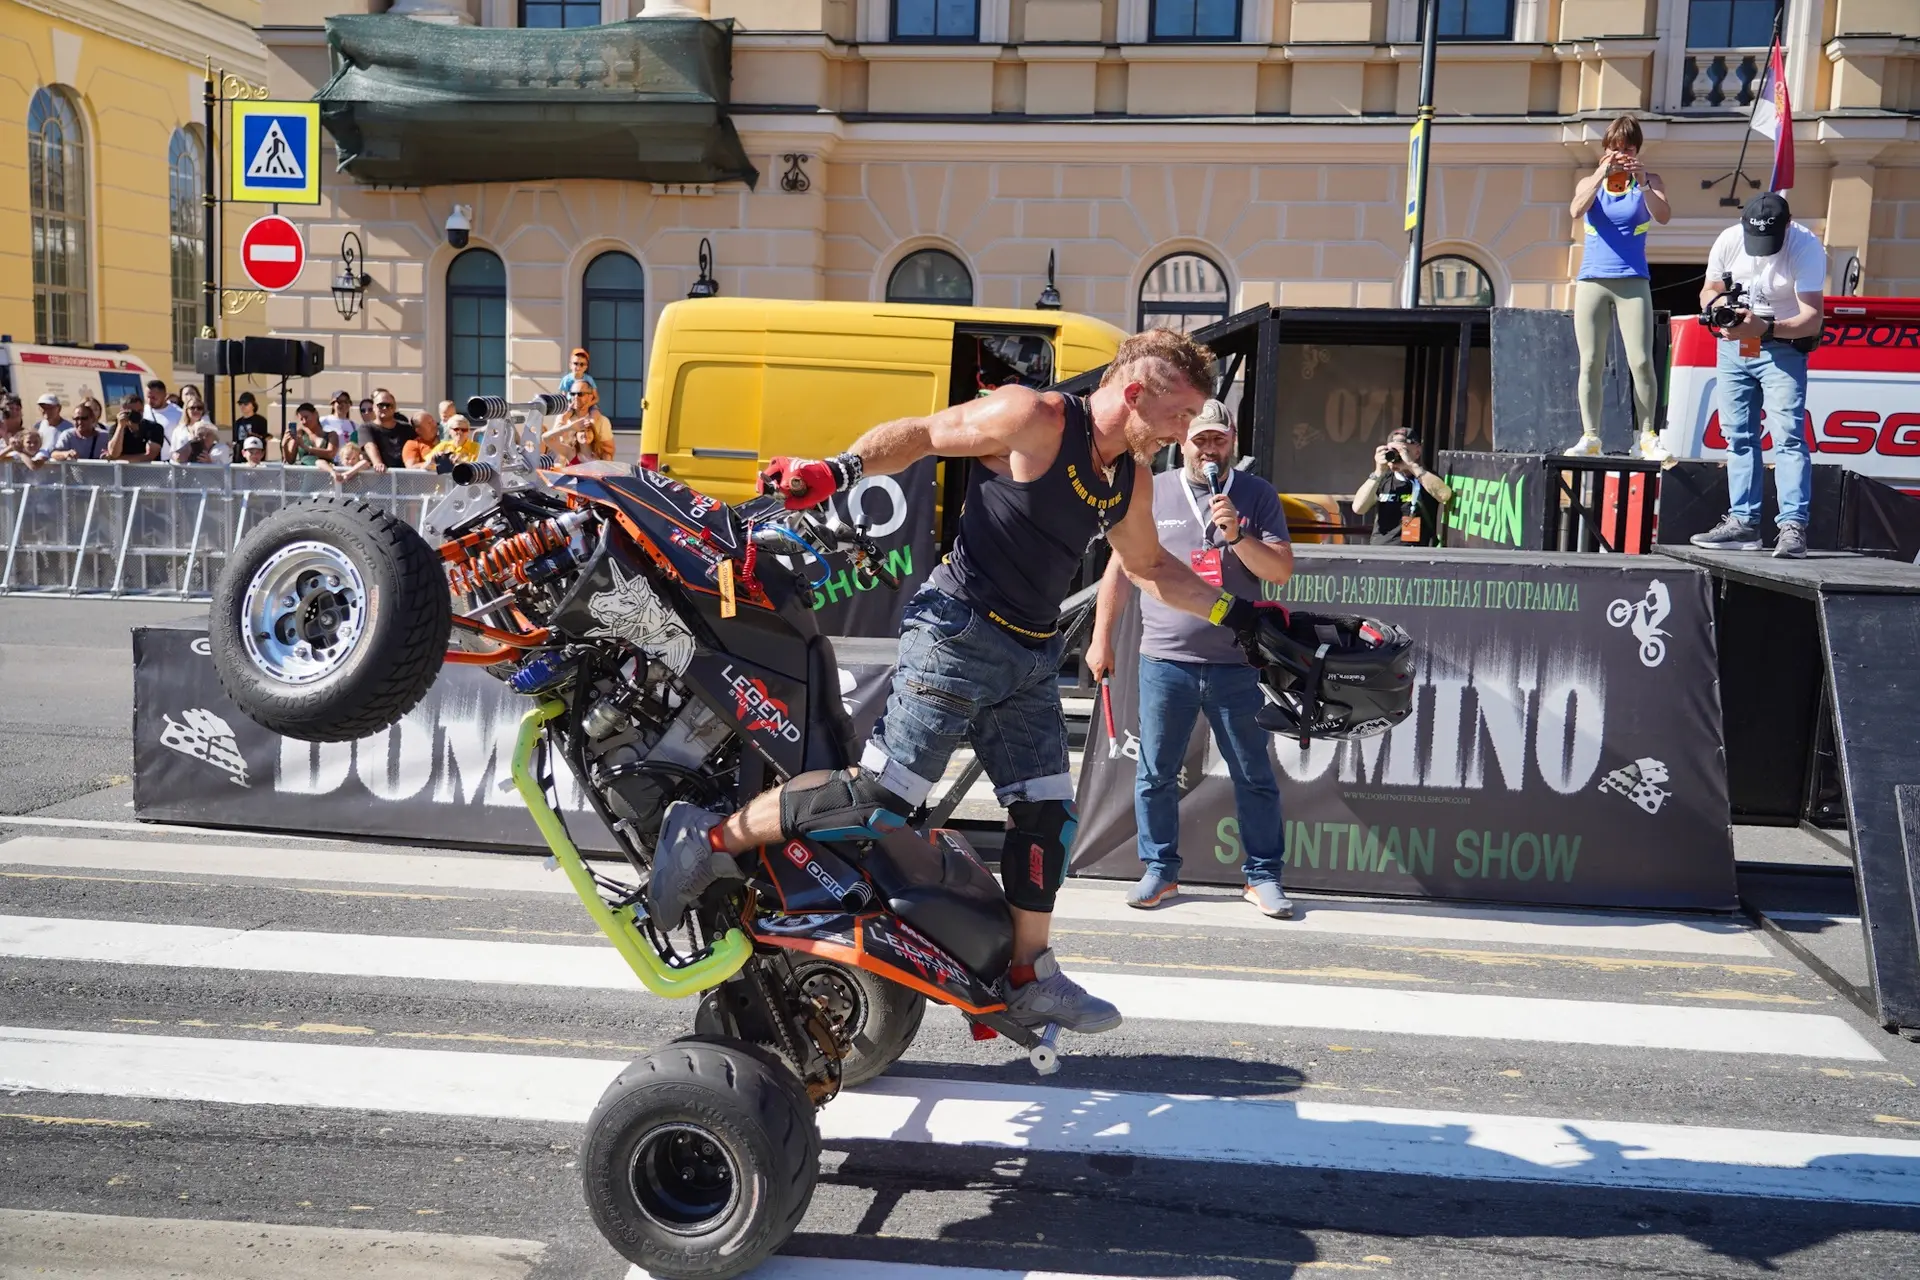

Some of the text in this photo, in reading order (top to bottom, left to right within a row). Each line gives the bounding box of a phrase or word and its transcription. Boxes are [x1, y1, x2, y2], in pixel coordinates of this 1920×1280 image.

[1072, 478, 1088, 500] HARD
[1440, 472, 1525, 547] EREGIN
[1260, 574, 1580, 612] ОРТИВНО-РАЗВЛЕКАТЕЛЬНАЯ ПРОГРАММА
[721, 664, 801, 742] LEGEND
[728, 689, 779, 739] STUNT TEAM
[1343, 791, 1471, 805] WWW.DOMINOTRIALSHOW.COM
[1214, 816, 1582, 883] SNTMAN SHOW
[868, 926, 970, 986] LEGEND
